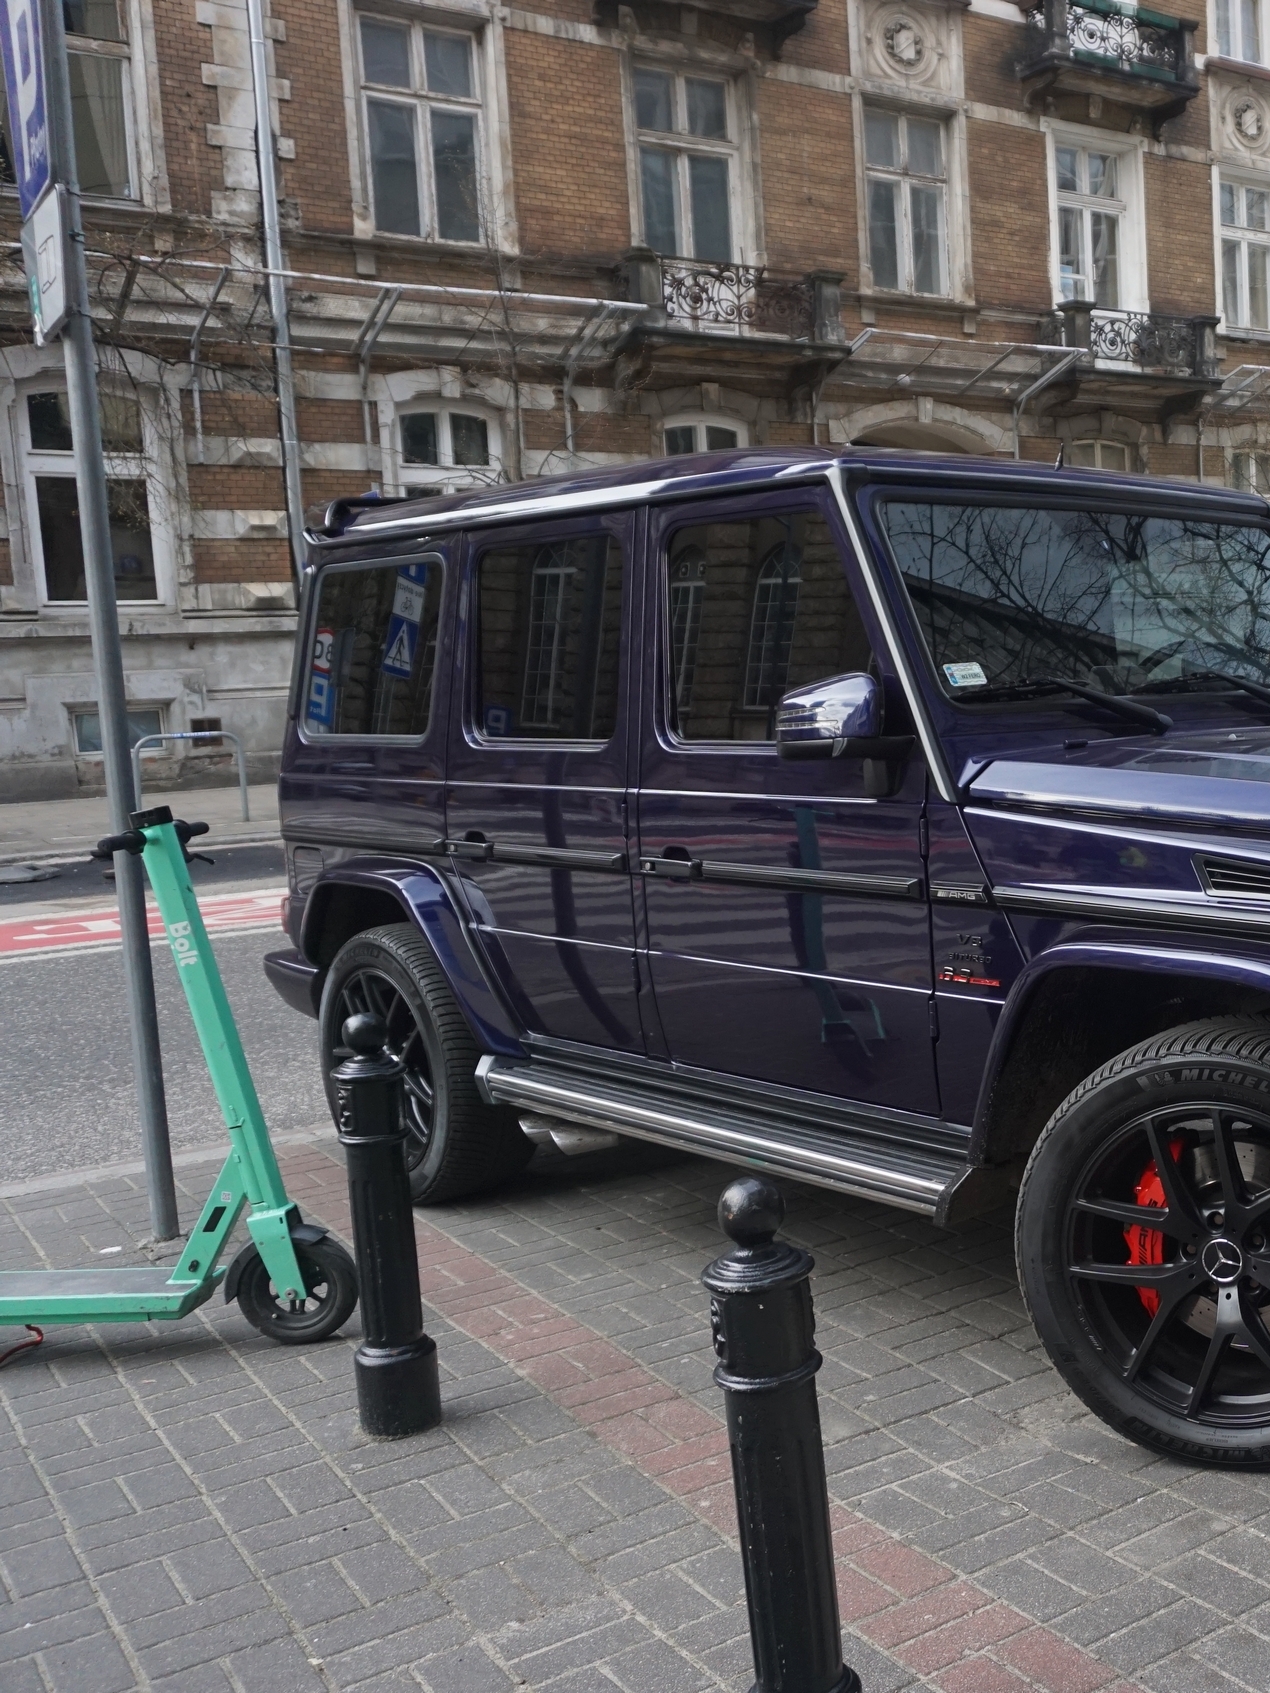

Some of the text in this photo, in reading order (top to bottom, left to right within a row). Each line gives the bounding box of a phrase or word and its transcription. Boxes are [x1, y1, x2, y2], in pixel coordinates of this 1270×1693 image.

[7, 0, 37, 180] P
[948, 891, 976, 900] AMG
[169, 921, 198, 967] Bolt
[948, 952, 992, 964] BITURBO
[1130, 1420, 1246, 1462] MICHELIN
